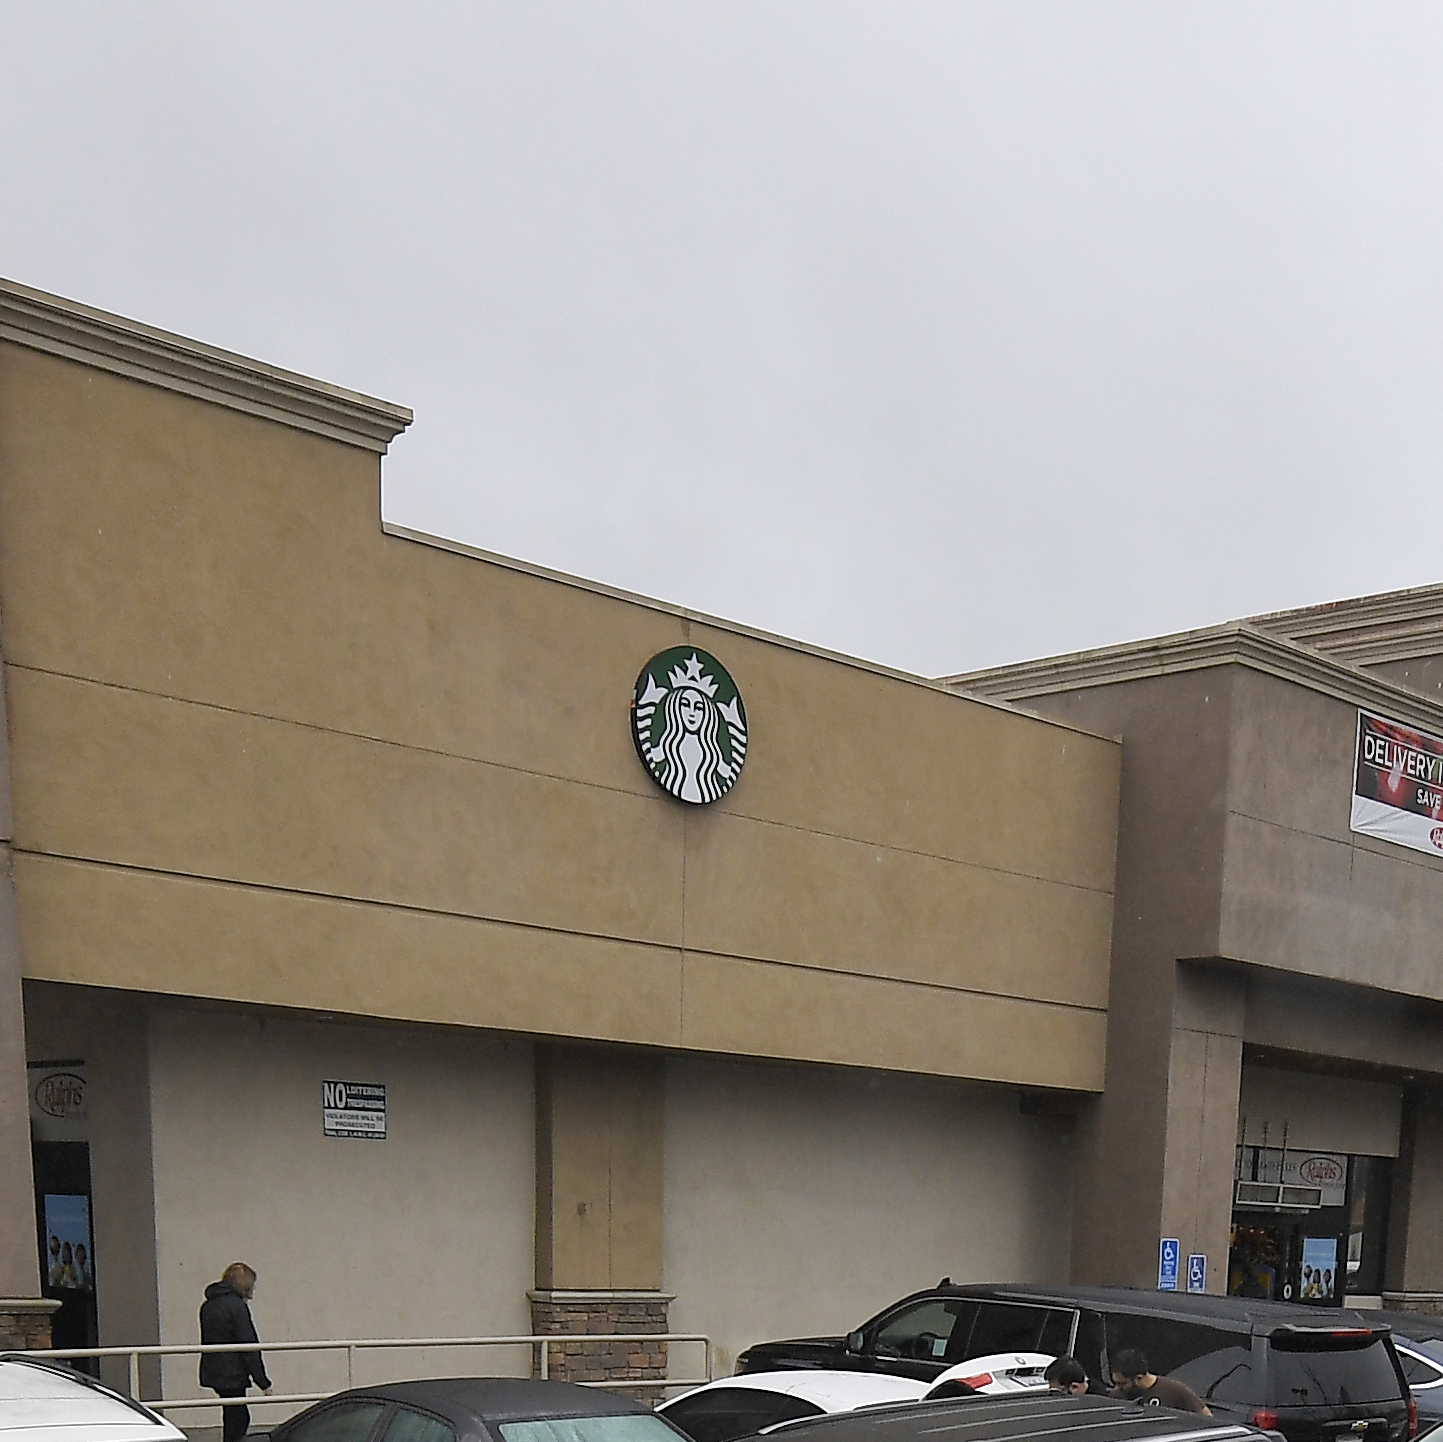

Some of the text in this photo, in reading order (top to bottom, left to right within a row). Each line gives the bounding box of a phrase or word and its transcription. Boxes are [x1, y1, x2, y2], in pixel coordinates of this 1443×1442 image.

[1364, 735, 1437, 780] DELIVERY
[1417, 788, 1441, 811] SAVE
[323, 1082, 347, 1109] NO
